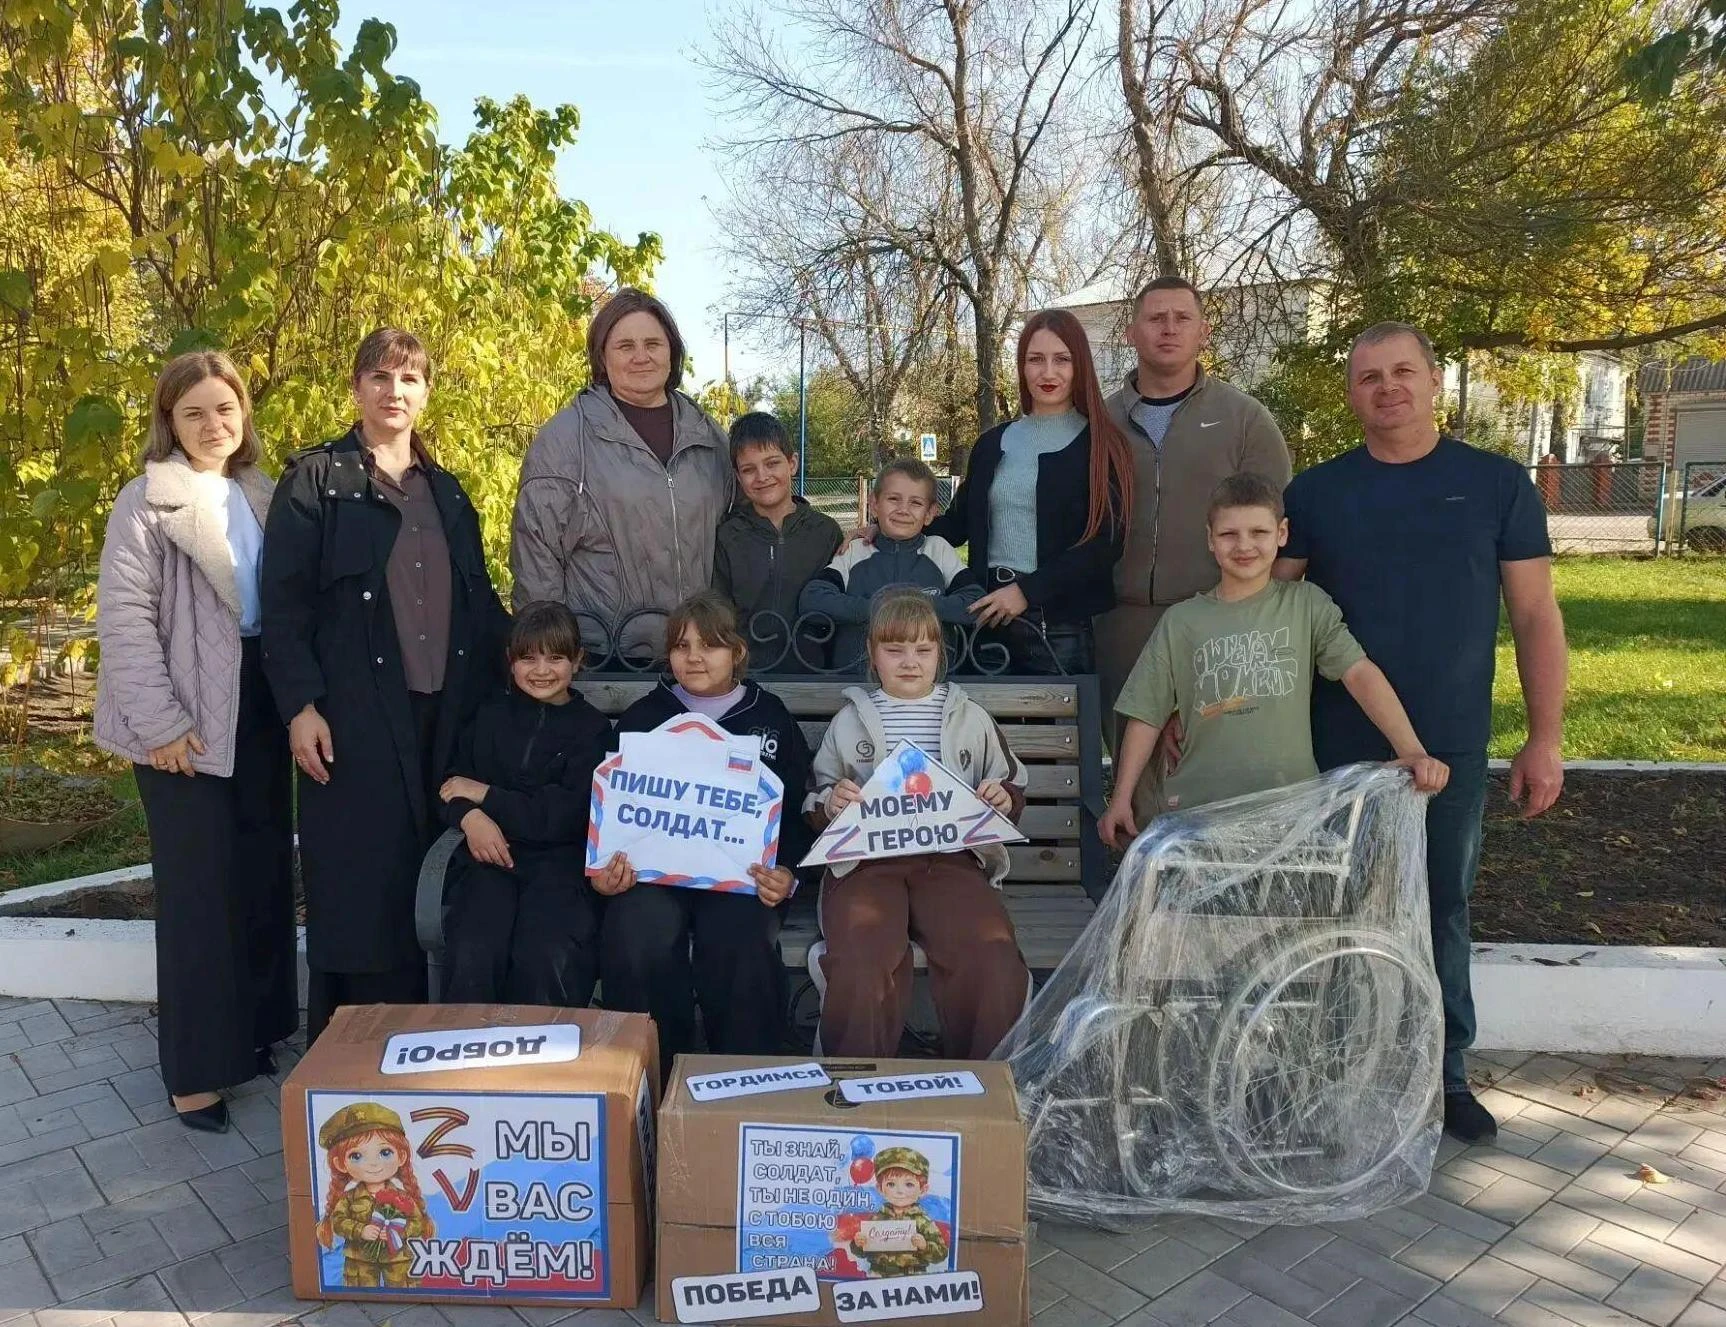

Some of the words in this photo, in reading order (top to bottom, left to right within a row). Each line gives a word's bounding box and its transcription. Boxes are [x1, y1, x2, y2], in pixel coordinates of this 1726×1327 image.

[610, 769, 691, 801] ПИШУ
[695, 784, 763, 819] ТЕБЕ,
[859, 790, 954, 820] МОЕМУ
[617, 803, 746, 845] СОЛДАТ...
[866, 823, 958, 853] ГЕРОЮ
[396, 1035, 547, 1065] ДОБРО!
[692, 1067, 824, 1092] ГОРДИМСЯ
[857, 1076, 962, 1097] ТОБОЙ!
[496, 1120, 591, 1161] МЫ
[751, 1140, 781, 1157] ТЫ
[785, 1139, 845, 1161] ЗНАЙ,
[754, 1163, 841, 1184] СОЛДАТ,
[485, 1181, 593, 1221] ВАС
[750, 1187, 781, 1203] ТЫ
[784, 1188, 810, 1204] НЕ
[813, 1189, 875, 1209] ОДИН,
[749, 1211, 761, 1226] С
[765, 1211, 837, 1230] ТОБОЮ
[749, 1233, 787, 1248] ВСЯ
[407, 1231, 594, 1285] ЖДЁМ!
[752, 1254, 836, 1271] СТРАНА!
[683, 1276, 813, 1306] ПОБЕДА
[836, 1291, 878, 1312] ЗА
[883, 1280, 980, 1307] НАМИ!
